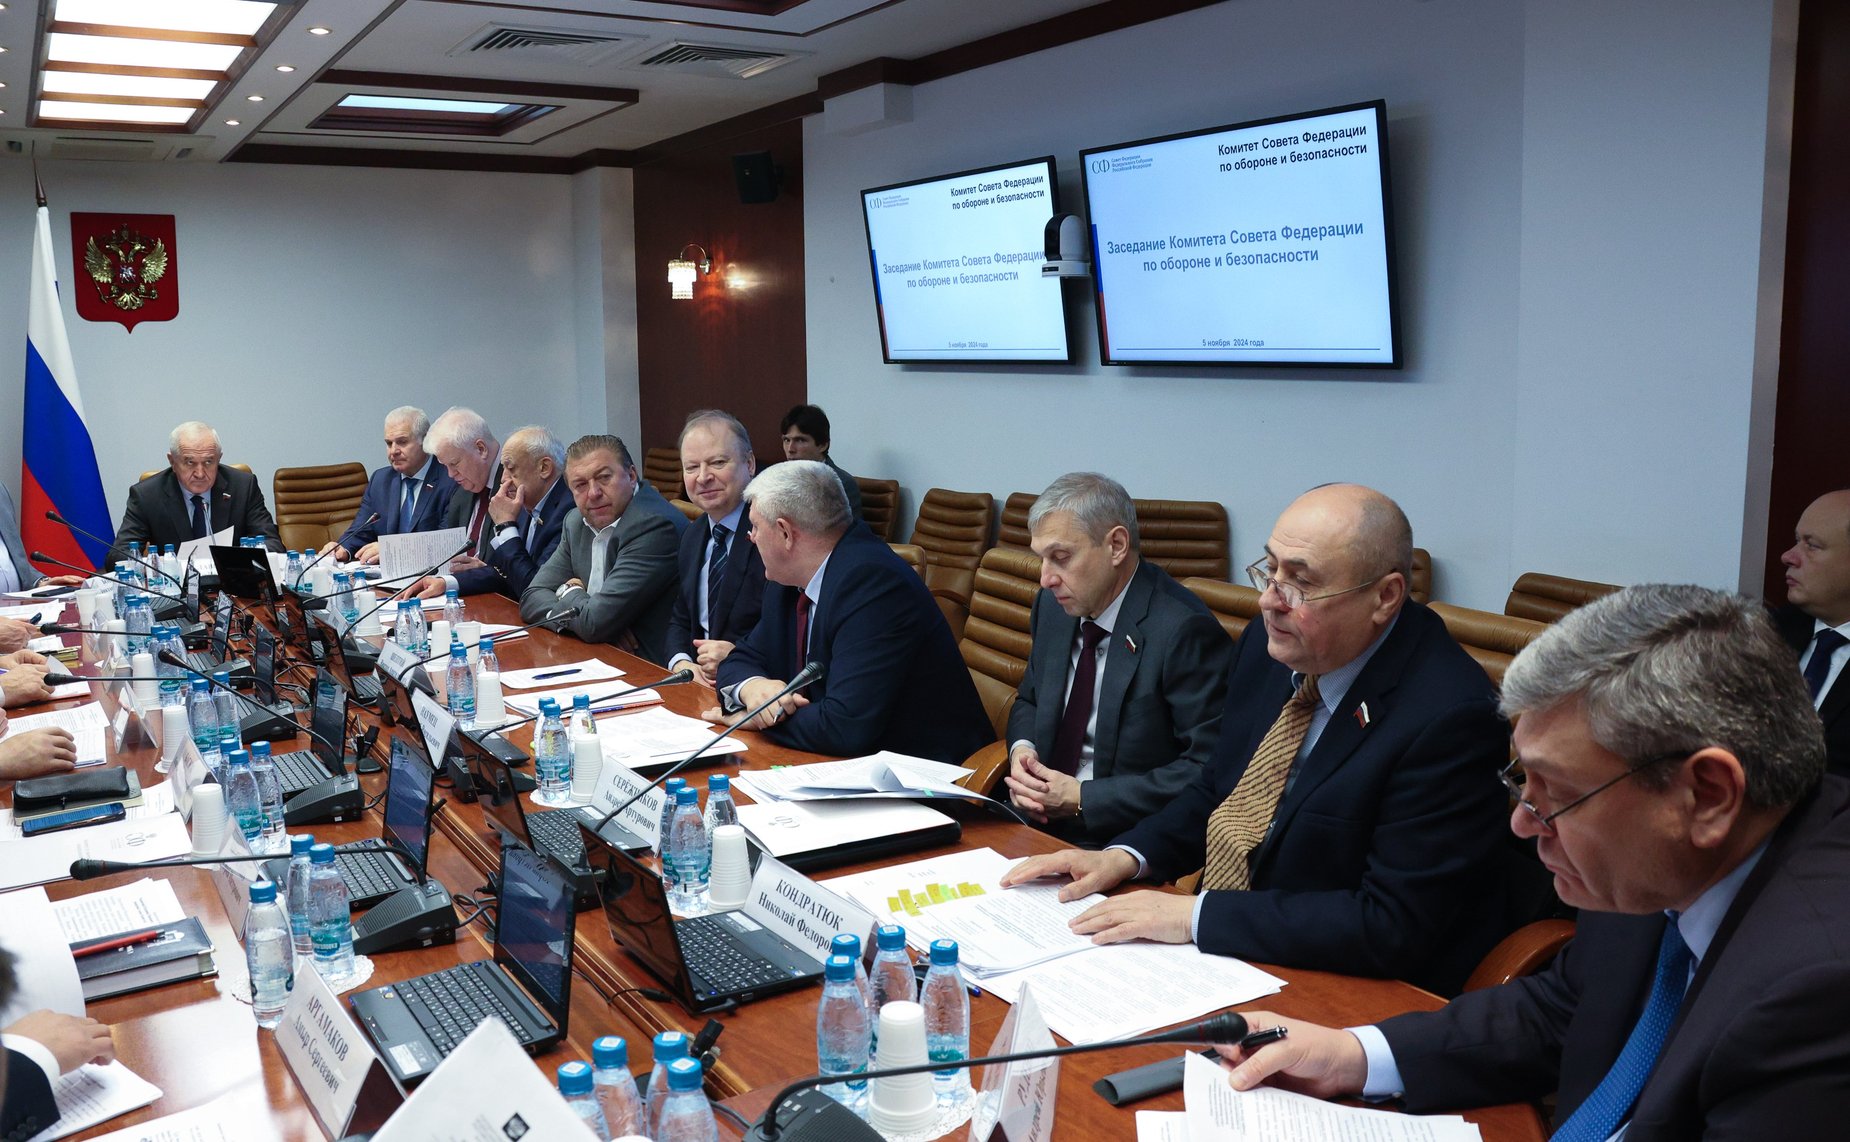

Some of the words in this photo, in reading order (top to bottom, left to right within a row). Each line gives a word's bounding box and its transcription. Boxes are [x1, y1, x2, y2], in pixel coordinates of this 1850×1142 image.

[1218, 141, 1259, 156] Комитет
[1262, 134, 1299, 150] Совета
[1302, 125, 1367, 143] Федерации
[1219, 162, 1232, 172] по
[1234, 155, 1278, 171] обороне
[1280, 155, 1287, 164] и
[1290, 144, 1367, 163] безопасности
[950, 187, 977, 197] Комитет
[978, 182, 1002, 193] Совета
[1003, 175, 1044, 188] Федерации
[952, 202, 961, 210] по
[962, 197, 989, 209] обороне
[996, 189, 1045, 204] безопасности
[1107, 239, 1166, 254] Заседание
[1169, 233, 1226, 249] Комитета
[1230, 229, 1277, 244] Совета
[1281, 222, 1364, 241] Федерации
[883, 262, 922, 274] Заседание
[923, 257, 960, 270] Комитета
[961, 254, 992, 267] Совета
[993, 250, 1045, 264] Федерации
[1143, 261, 1157, 271] по
[1160, 257, 1211, 272] обороне
[1215, 256, 1222, 267] и
[1226, 249, 1319, 266] безопасности
[907, 278, 917, 288] по
[918, 275, 951, 288] обороне
[952, 276, 959, 285] и
[960, 271, 1019, 284] безопасности
[1202, 339, 1206, 347] 5
[1207, 339, 1231, 347] ноября
[1233, 339, 1249, 347] 2024
[758, 891, 795, 927] Николай
[776, 879, 843, 931] КОНДРАТЮК
[306, 994, 349, 1062] АРГАМАКОВ
[308, 1038, 340, 1094] Сергеевич
